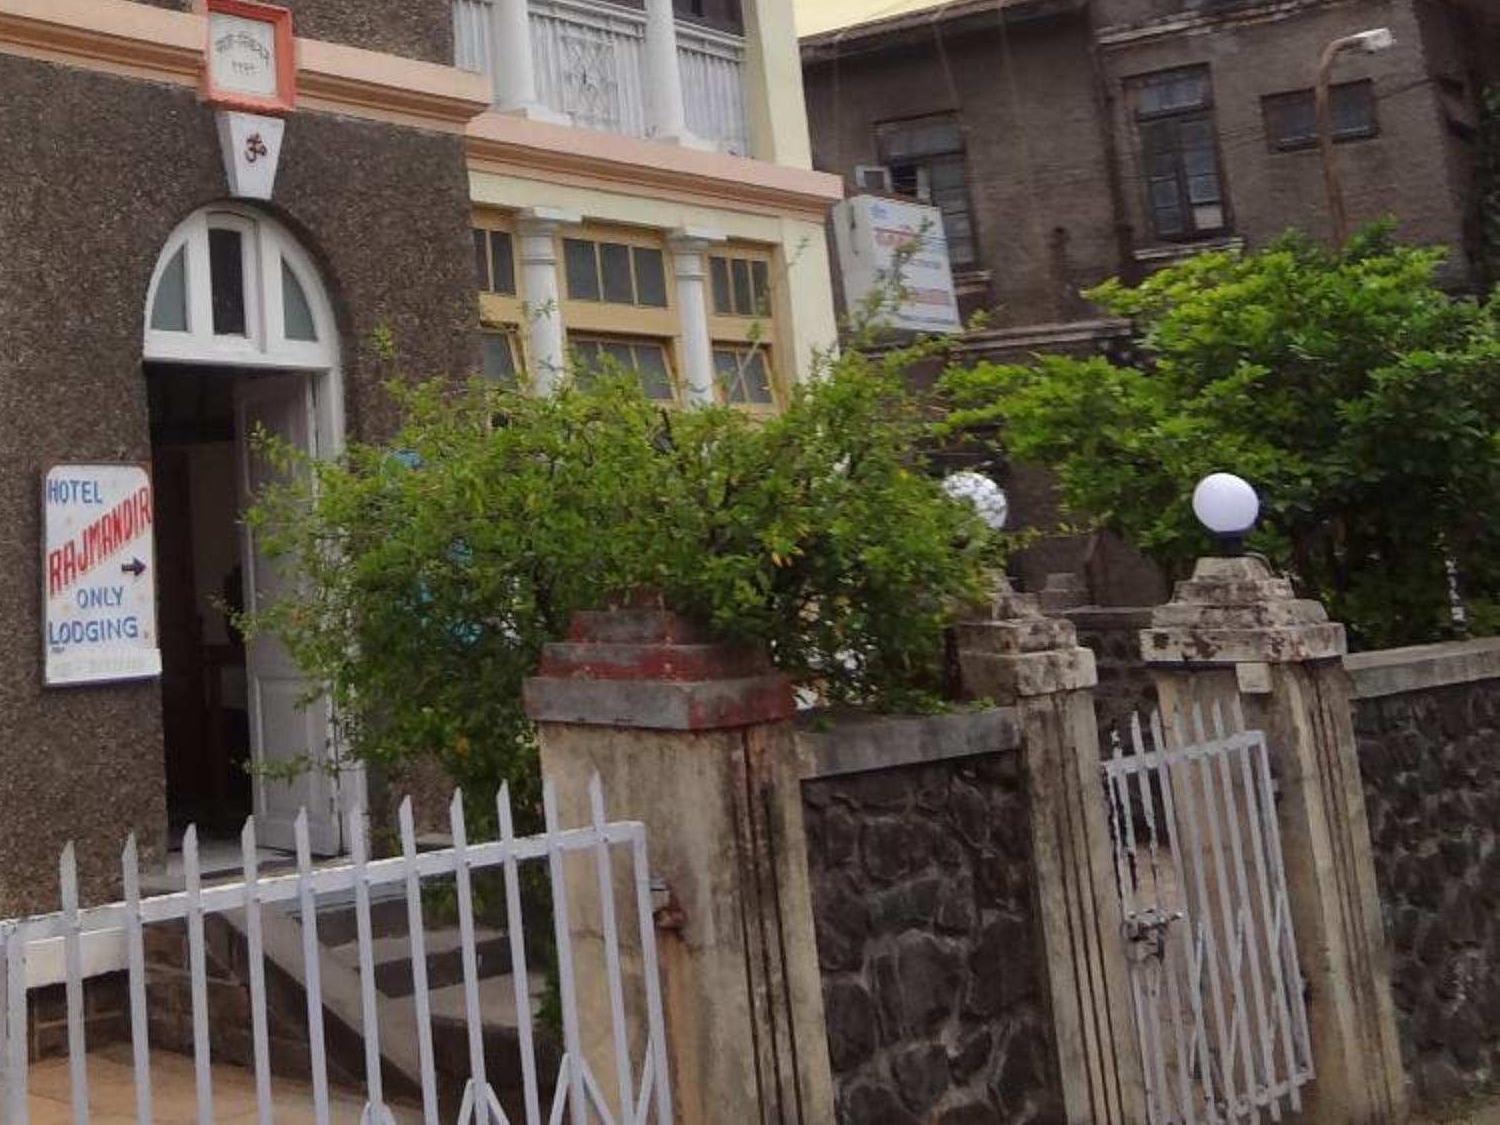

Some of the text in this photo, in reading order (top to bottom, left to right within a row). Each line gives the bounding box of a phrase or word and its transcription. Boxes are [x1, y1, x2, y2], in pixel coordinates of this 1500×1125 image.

[46, 479, 102, 504] HOTEL
[49, 486, 152, 596] RAJMANDIR
[76, 586, 124, 609] ONLY
[47, 616, 138, 646] LODGING
